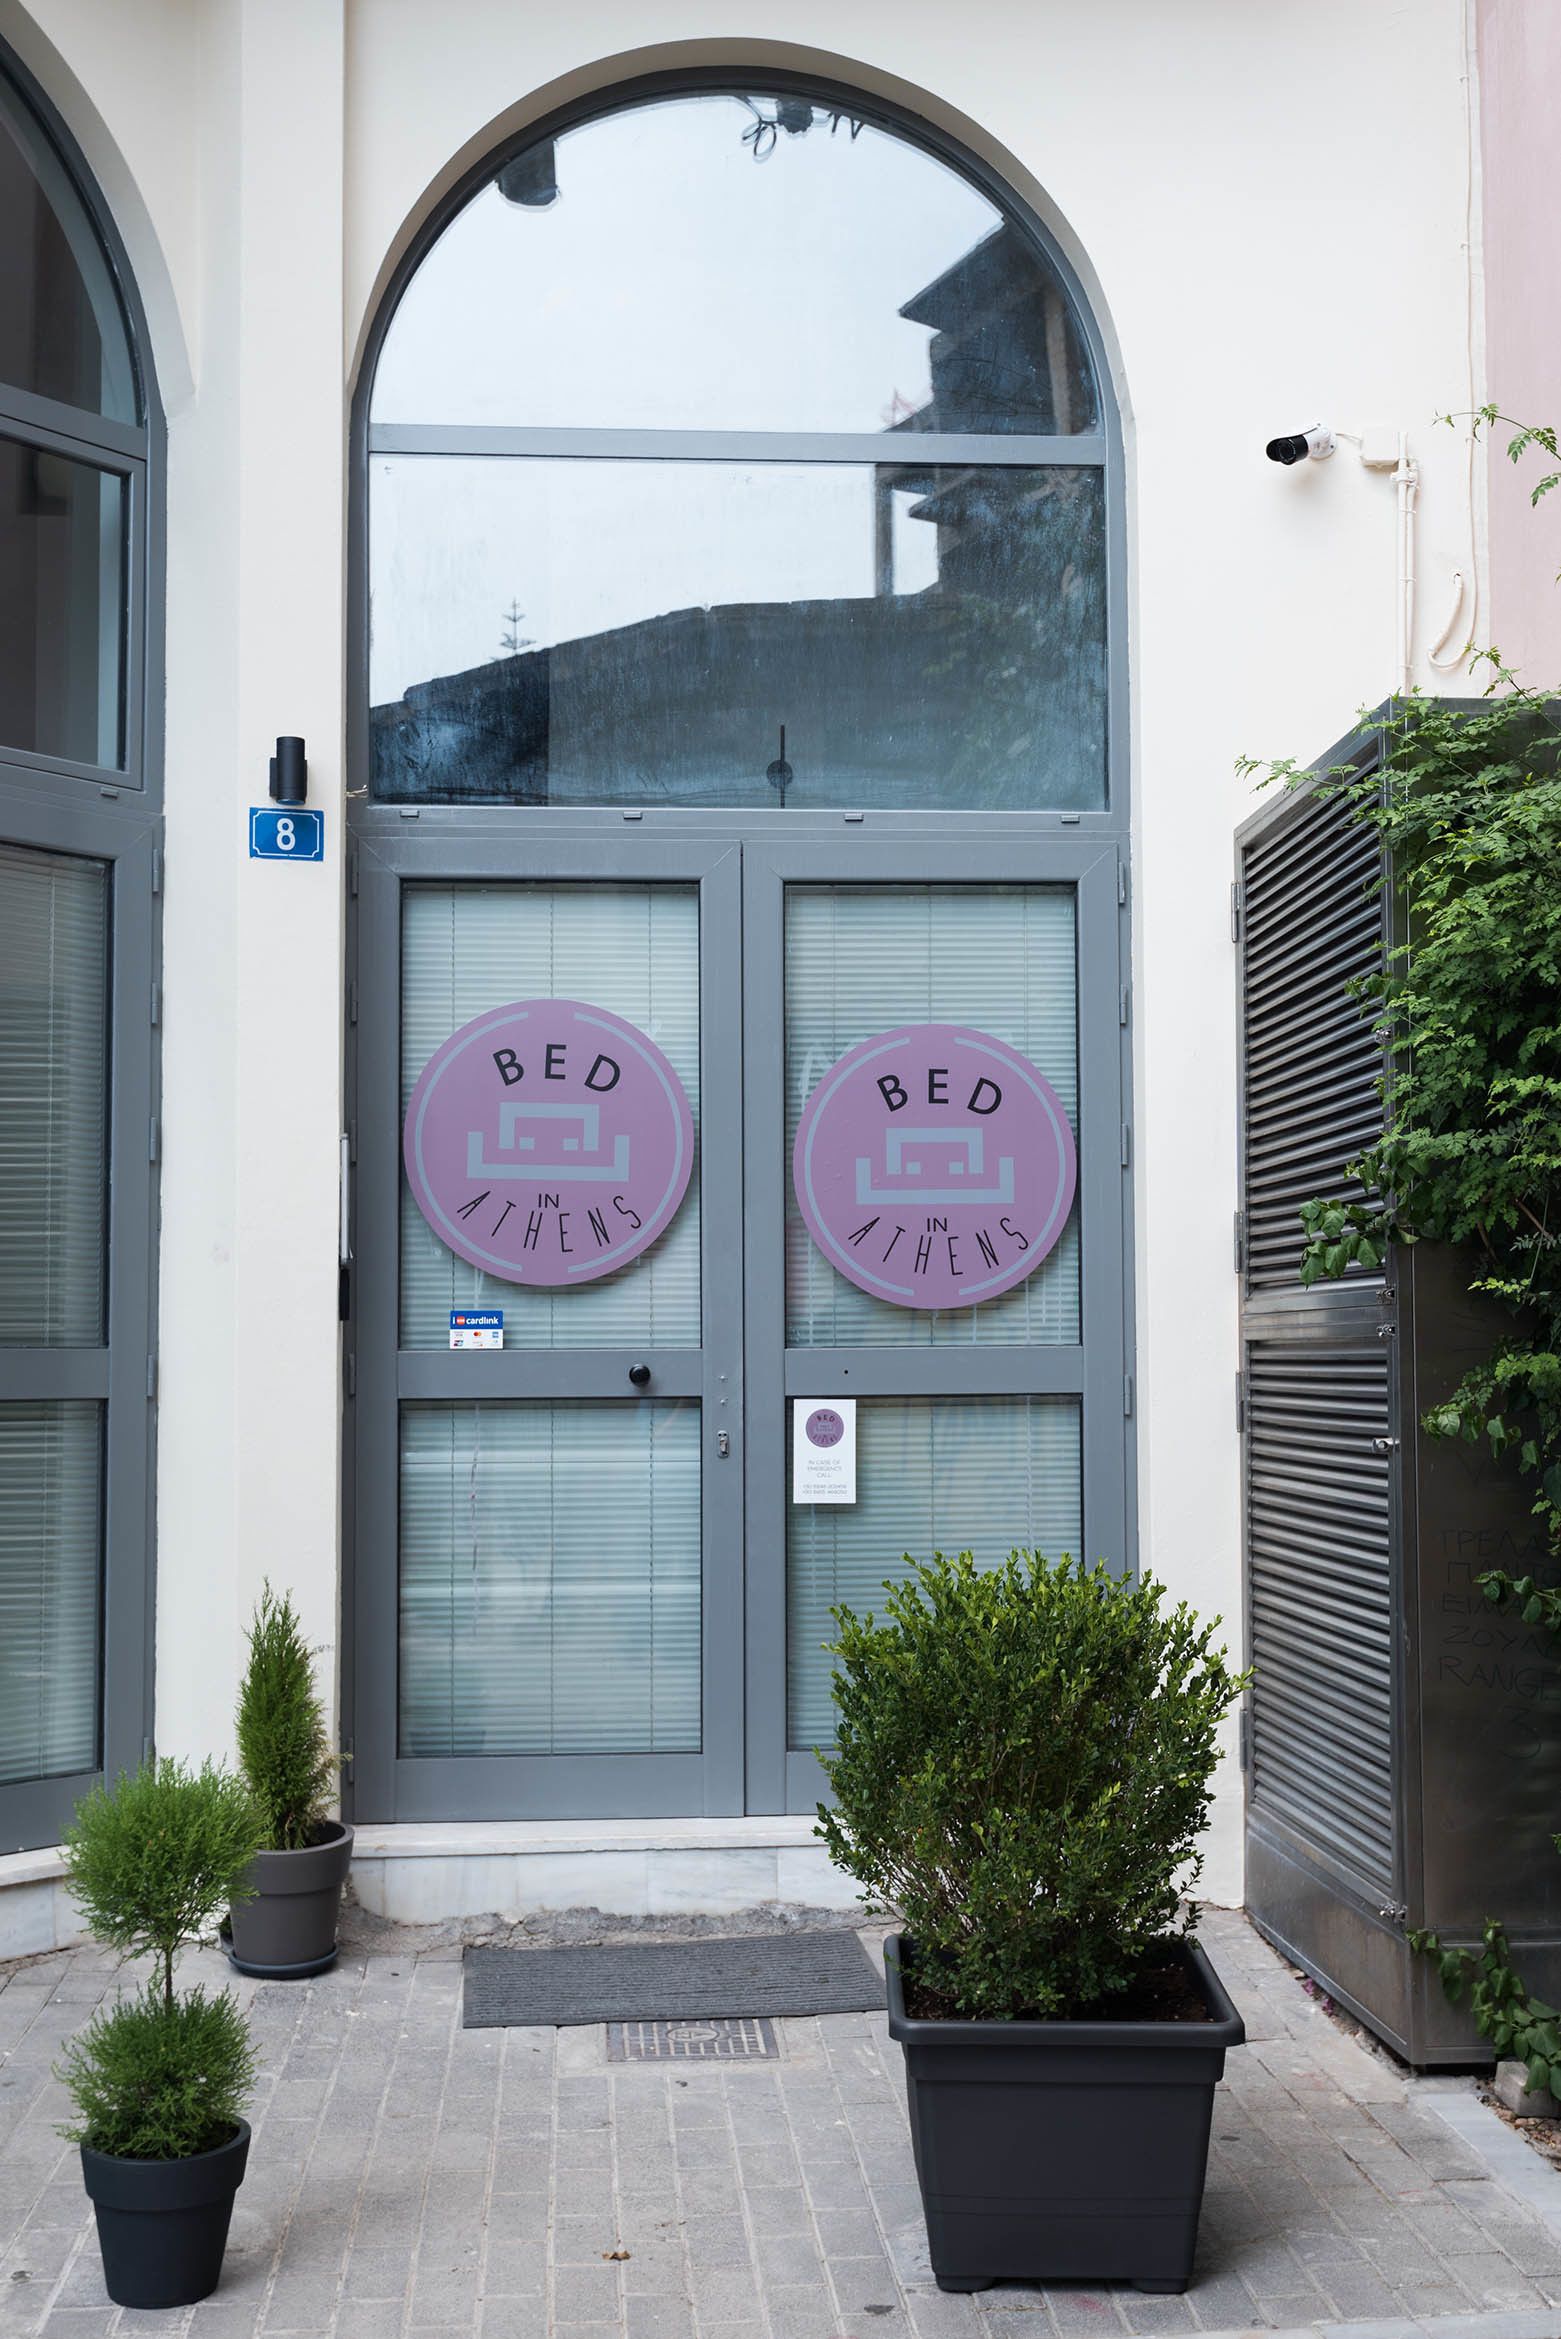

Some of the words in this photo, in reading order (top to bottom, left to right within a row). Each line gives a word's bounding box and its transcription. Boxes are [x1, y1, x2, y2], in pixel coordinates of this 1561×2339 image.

[276, 818, 296, 851] 8
[492, 1043, 621, 1092] BED
[876, 1068, 1003, 1115] BED
[537, 1193, 560, 1209] IN
[456, 1190, 642, 1253] ATHENS
[926, 1217, 948, 1233] IN
[847, 1216, 1029, 1276] ATHENS
[465, 1316, 499, 1325] cardlink
